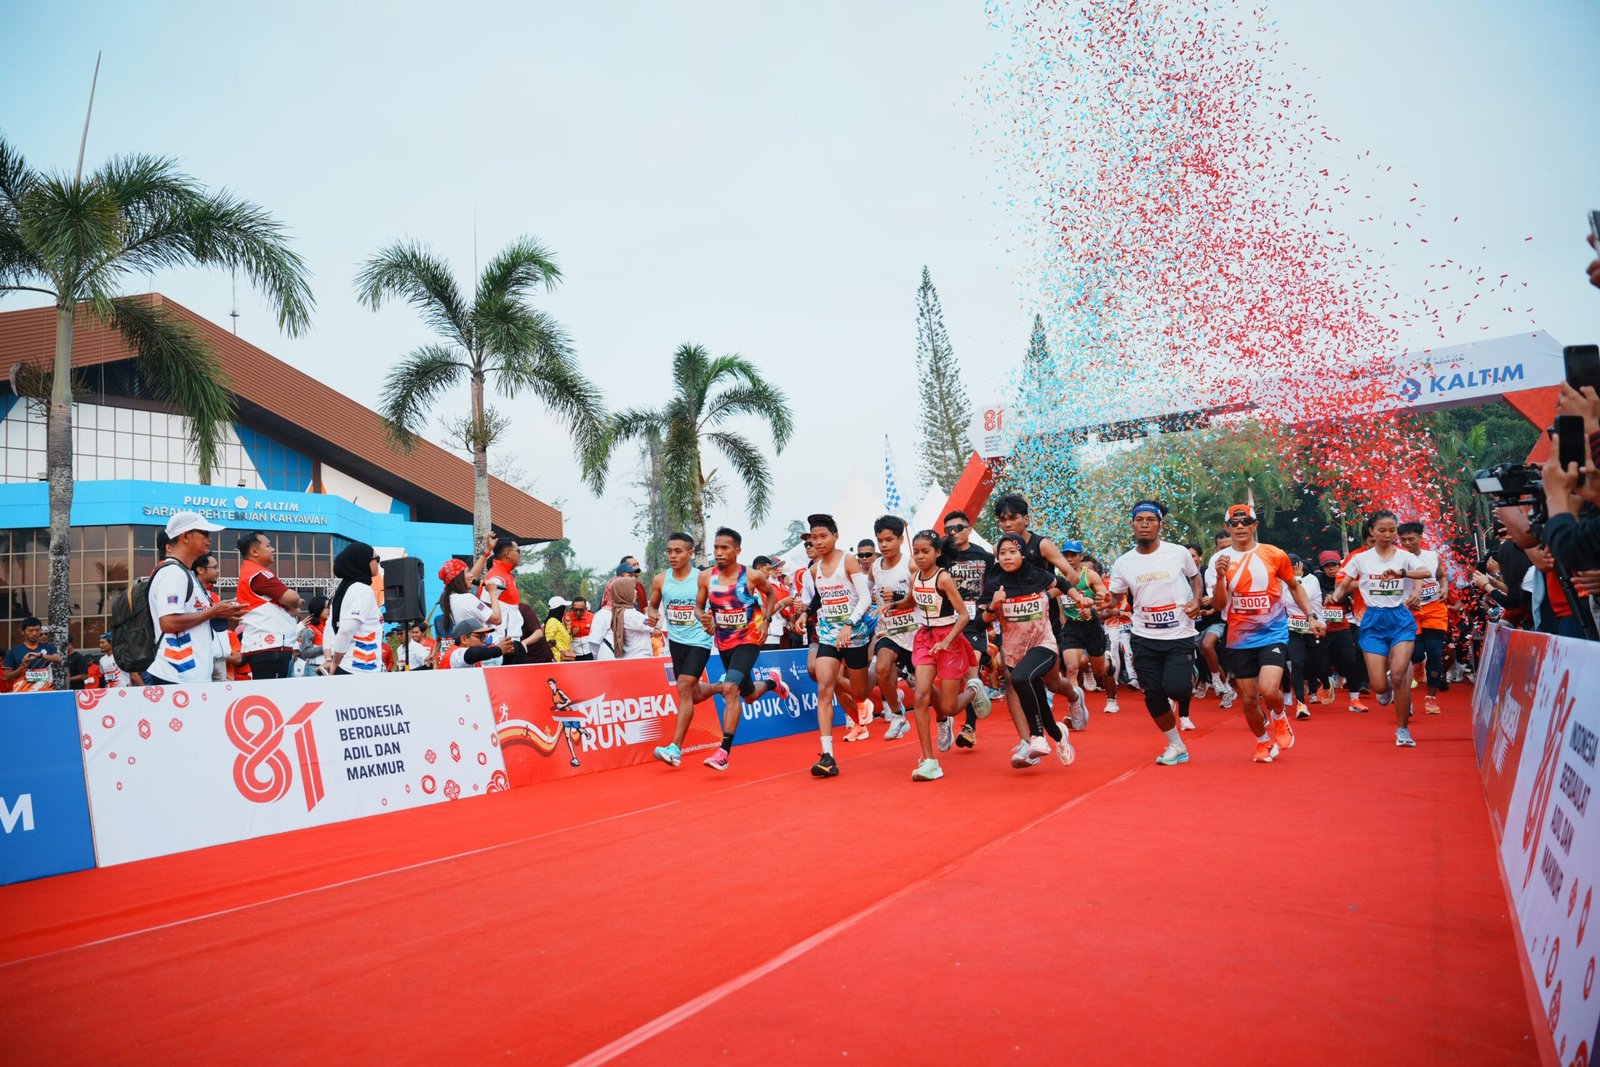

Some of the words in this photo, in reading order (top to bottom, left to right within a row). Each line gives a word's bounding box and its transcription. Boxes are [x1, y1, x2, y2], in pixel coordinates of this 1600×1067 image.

[1430, 363, 1524, 394] KALTIM
[984, 409, 1004, 431] 81
[184, 496, 228, 507] PUPUK
[254, 500, 299, 511] KALTIM
[199, 509, 267, 522] PERTEMUAN
[269, 513, 328, 525] KARYAWAN
[1379, 580, 1400, 589] 4717
[828, 603, 848, 615] 4439
[1013, 601, 1040, 615] 4429
[1240, 597, 1267, 608] 9002
[673, 611, 692, 620] 4057
[723, 613, 745, 624] 4072
[892, 614, 914, 626] 4334
[1151, 611, 1175, 622] 1029
[1324, 610, 1342, 618] 5005
[1291, 619, 1309, 628] 4866
[336, 704, 403, 722] INDONESIA
[576, 694, 678, 727] MERDEKA
[741, 697, 784, 720] UPUK
[339, 721, 411, 741] BERDAULAT
[582, 722, 632, 752] RUN
[225, 695, 325, 813] 81
[343, 745, 373, 761] ADIL
[375, 741, 401, 757] DAN
[346, 760, 405, 781] MAKMUR
